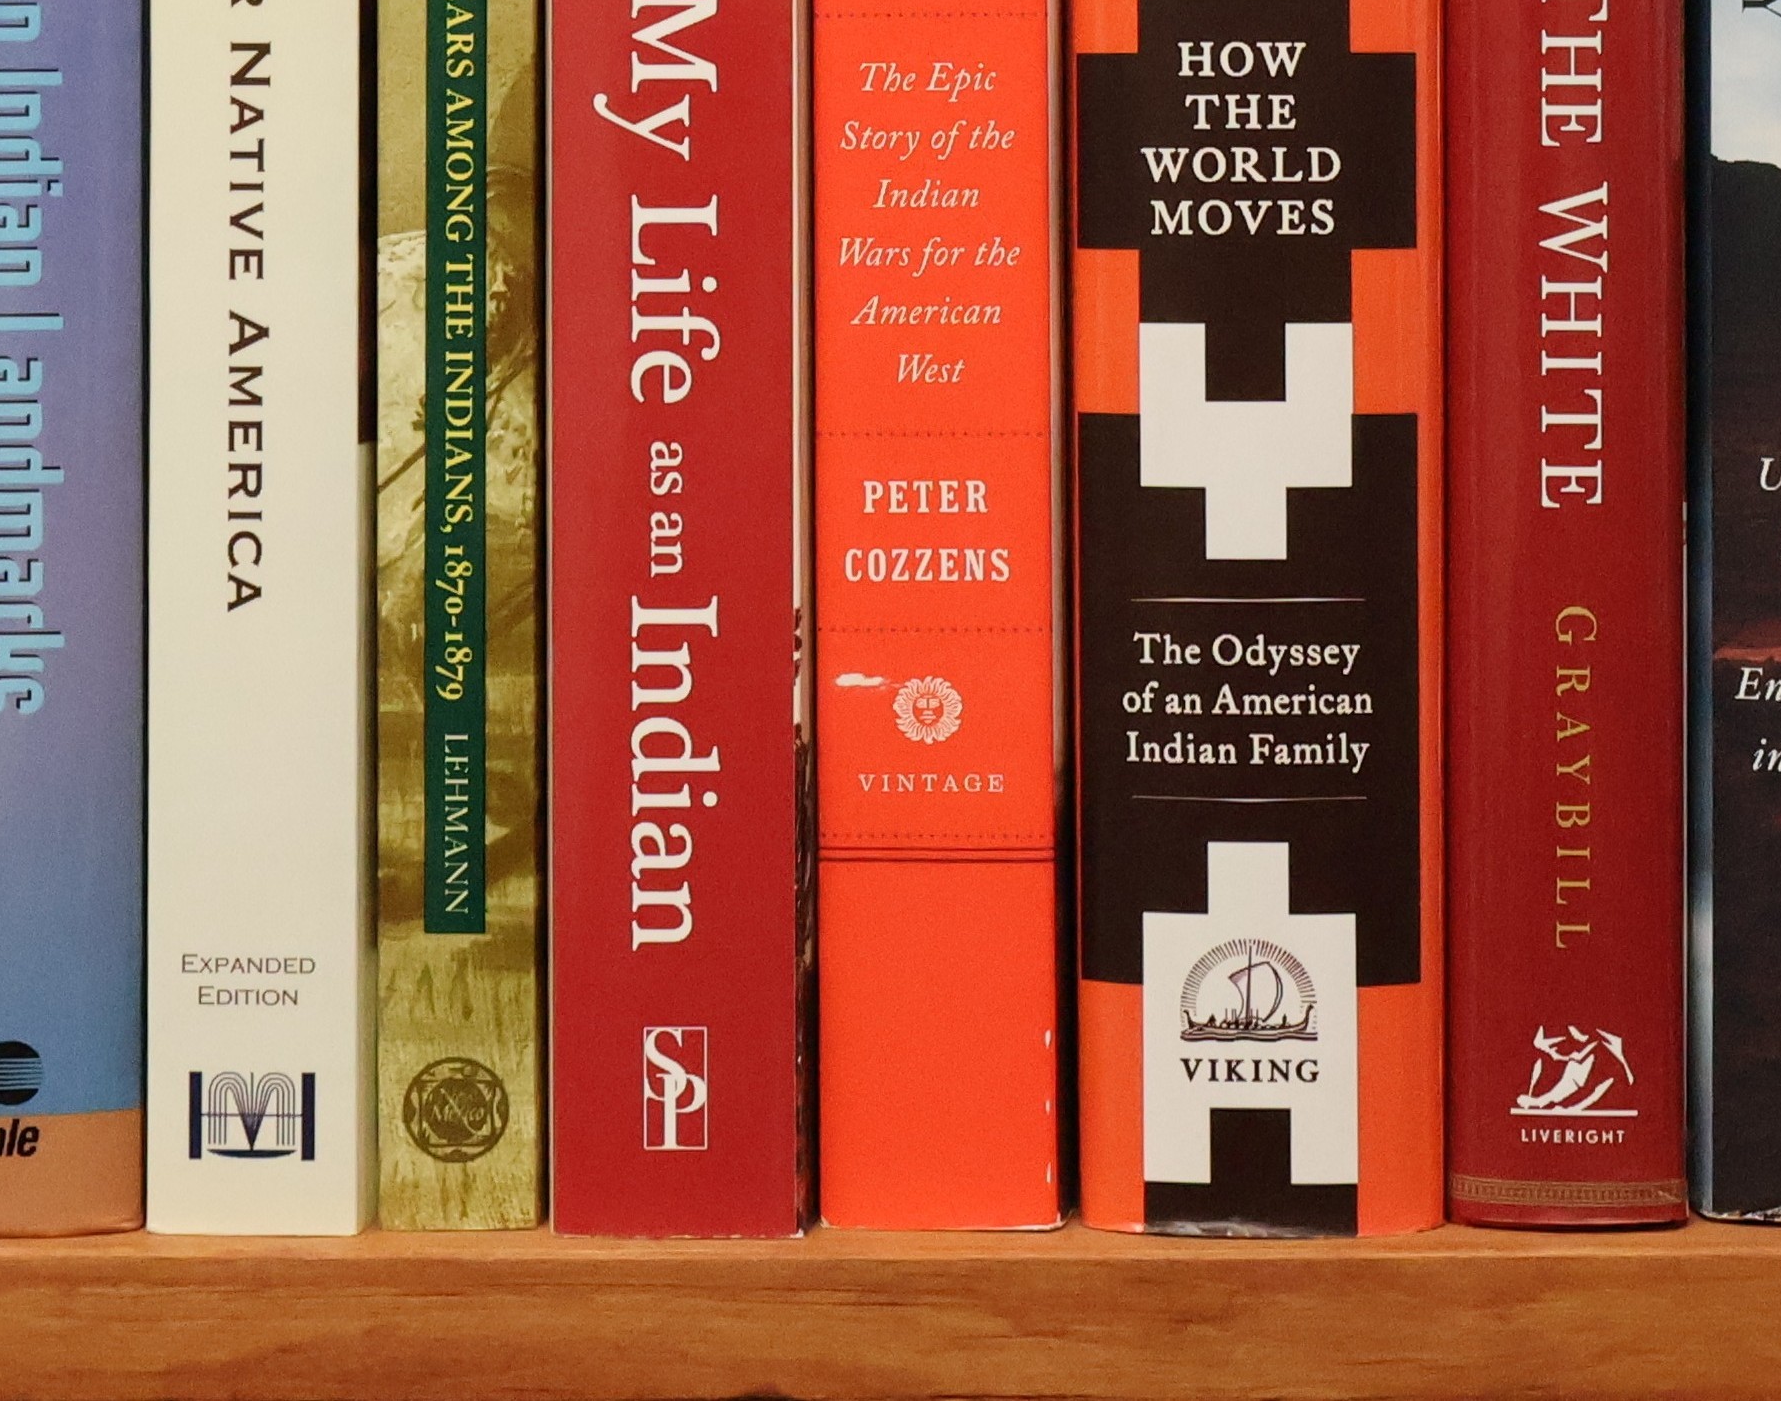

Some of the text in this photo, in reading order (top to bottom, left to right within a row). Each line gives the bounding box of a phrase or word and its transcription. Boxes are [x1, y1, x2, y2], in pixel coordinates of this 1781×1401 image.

[860, 62, 997, 102] The Epic
[840, 119, 1016, 161] Story of the
[446, 89, 474, 242] AMONG
[873, 179, 980, 208] Indian
[839, 236, 1021, 278] Wars for the
[446, 254, 473, 339] THE
[631, 195, 720, 403] Life
[851, 295, 1002, 325] American
[1539, 182, 1607, 507] WHITE
[897, 354, 965, 382] West
[440, 351, 473, 532] INDIANS,
[651, 442, 682, 495] as
[651, 512, 682, 577] an
[1133, 632, 1360, 676] The Odyssey
[1123, 681, 1373, 715] of an American
[631, 596, 720, 951] Indian
[1127, 731, 1370, 773] Indian Family
[859, 774, 1004, 792] VINTAGE
[1556, 606, 1597, 948] GRAYBILL
[445, 734, 468, 913] LEHMANN
[1180, 1058, 1319, 1082] VIKING
[1522, 1129, 1624, 1143] LIVERIGHT
